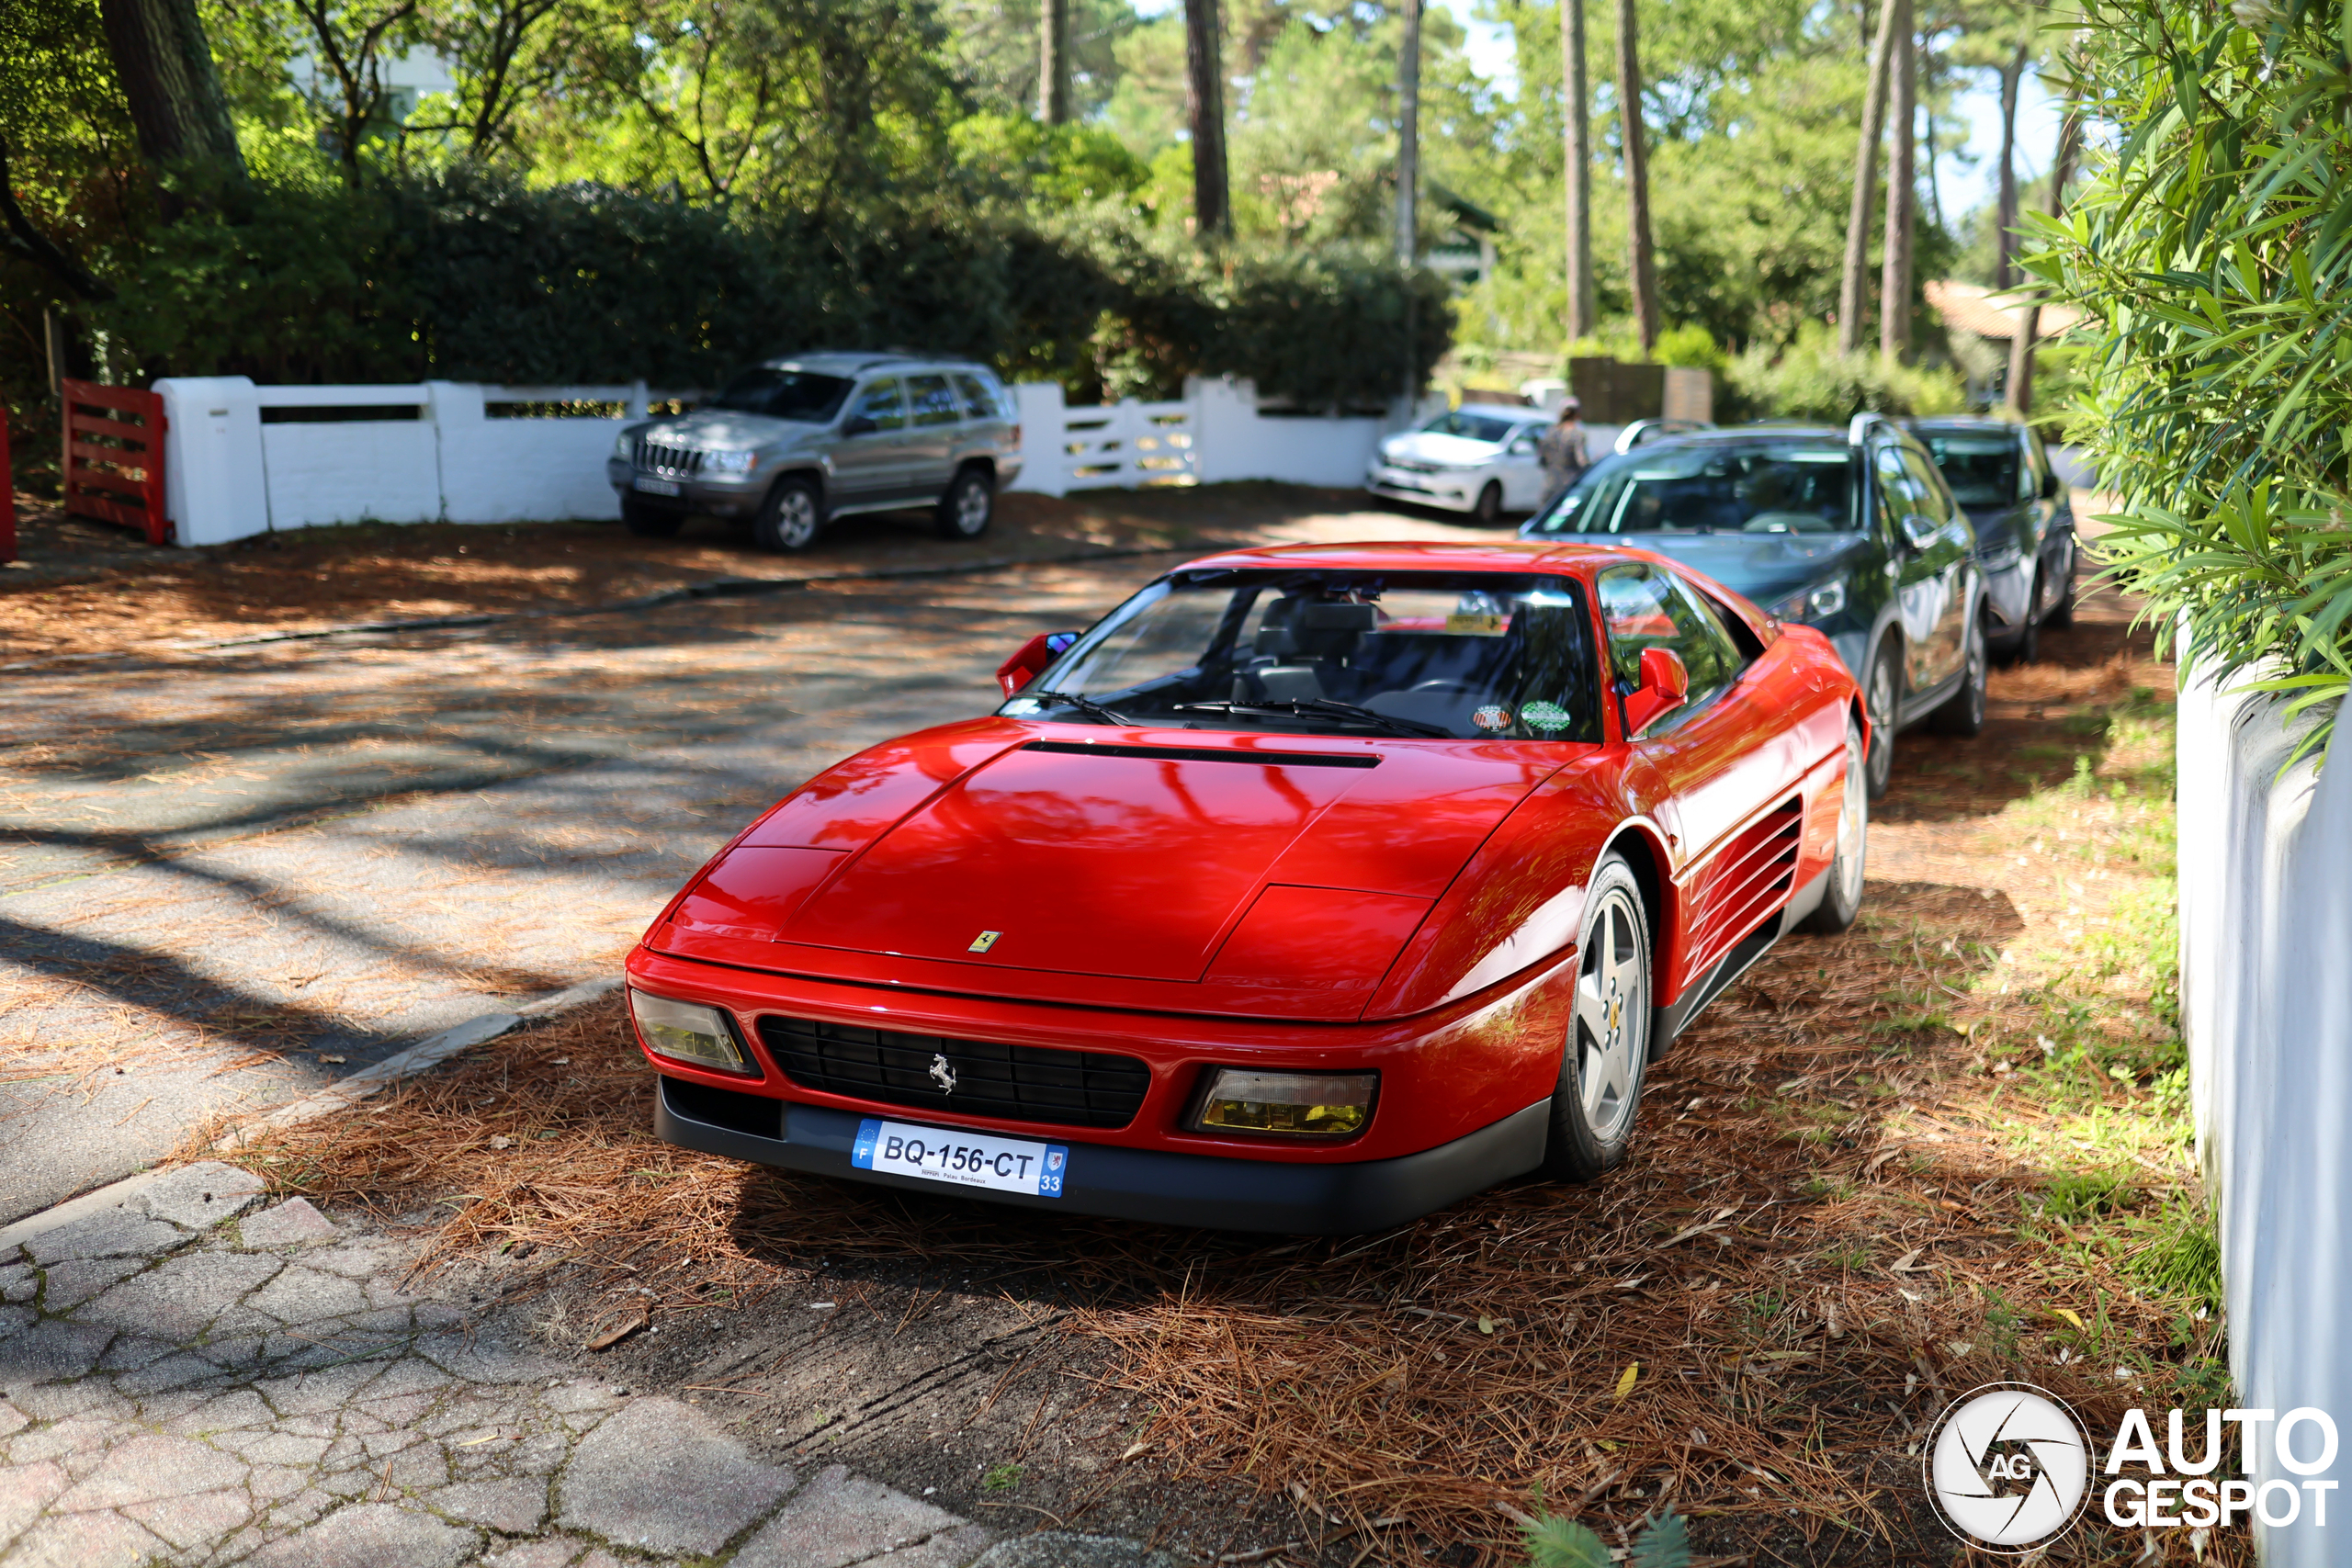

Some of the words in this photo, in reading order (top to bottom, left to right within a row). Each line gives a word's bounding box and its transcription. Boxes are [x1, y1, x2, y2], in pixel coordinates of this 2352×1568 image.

[859, 1148, 868, 1159] F
[884, 1135, 1034, 1179] BQ-156-CT
[944, 1172, 957, 1180] Palau
[961, 1175, 986, 1184] Bordeaux
[1040, 1175, 1060, 1191] 33
